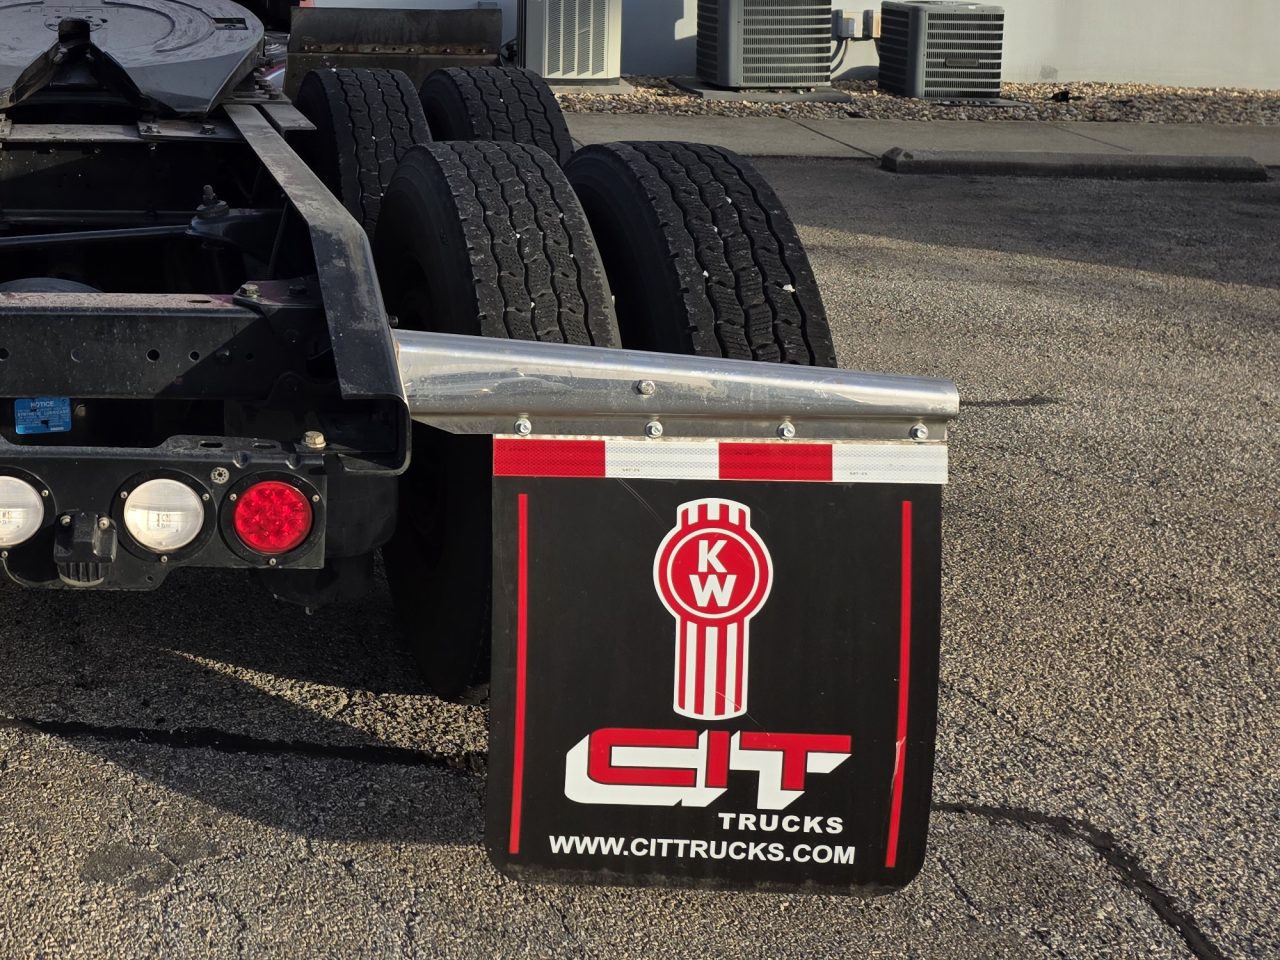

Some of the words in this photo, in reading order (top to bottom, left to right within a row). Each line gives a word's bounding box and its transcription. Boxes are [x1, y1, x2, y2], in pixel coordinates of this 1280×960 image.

[563, 728, 852, 810] CIT
[718, 811, 845, 835] TRUCKS
[548, 835, 856, 865] WWW.CITTRUCKS.COM
